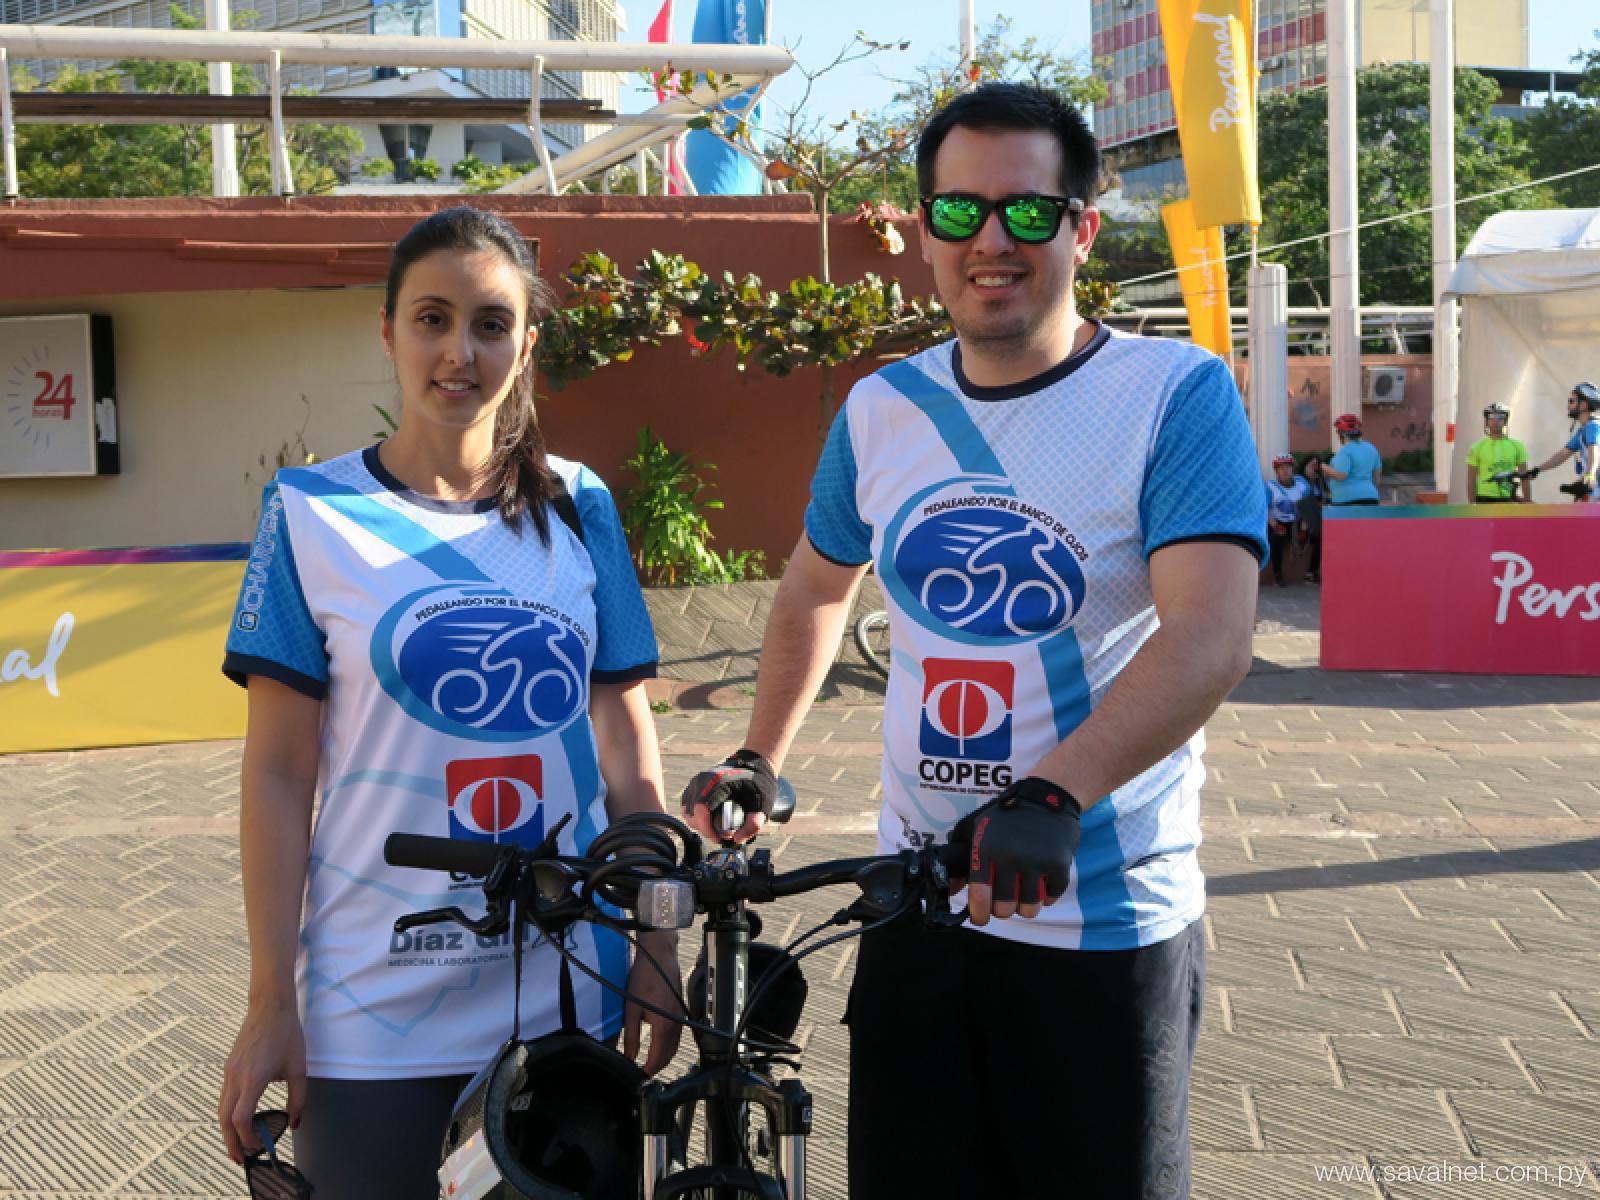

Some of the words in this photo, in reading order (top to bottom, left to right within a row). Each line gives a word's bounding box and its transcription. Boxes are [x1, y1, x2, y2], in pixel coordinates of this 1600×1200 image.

[1192, 13, 1249, 132] Personal
[33, 371, 77, 421] 24
[924, 496, 986, 516] PEDALEANDO
[988, 497, 1008, 509] POR
[1008, 501, 1019, 512] EL
[1020, 503, 1054, 527] BANCO
[1053, 521, 1067, 536] DE
[1066, 534, 1088, 561] OJOS
[415, 597, 482, 621] PEDALEANDO
[484, 597, 507, 607] POR
[510, 598, 519, 608] EL
[522, 601, 558, 618] BANCO
[560, 613, 572, 625] DE
[0, 611, 76, 696] al
[919, 758, 1012, 788] COPEG
[390, 926, 464, 952] Díaz
[387, 957, 434, 967] MEDICINA
